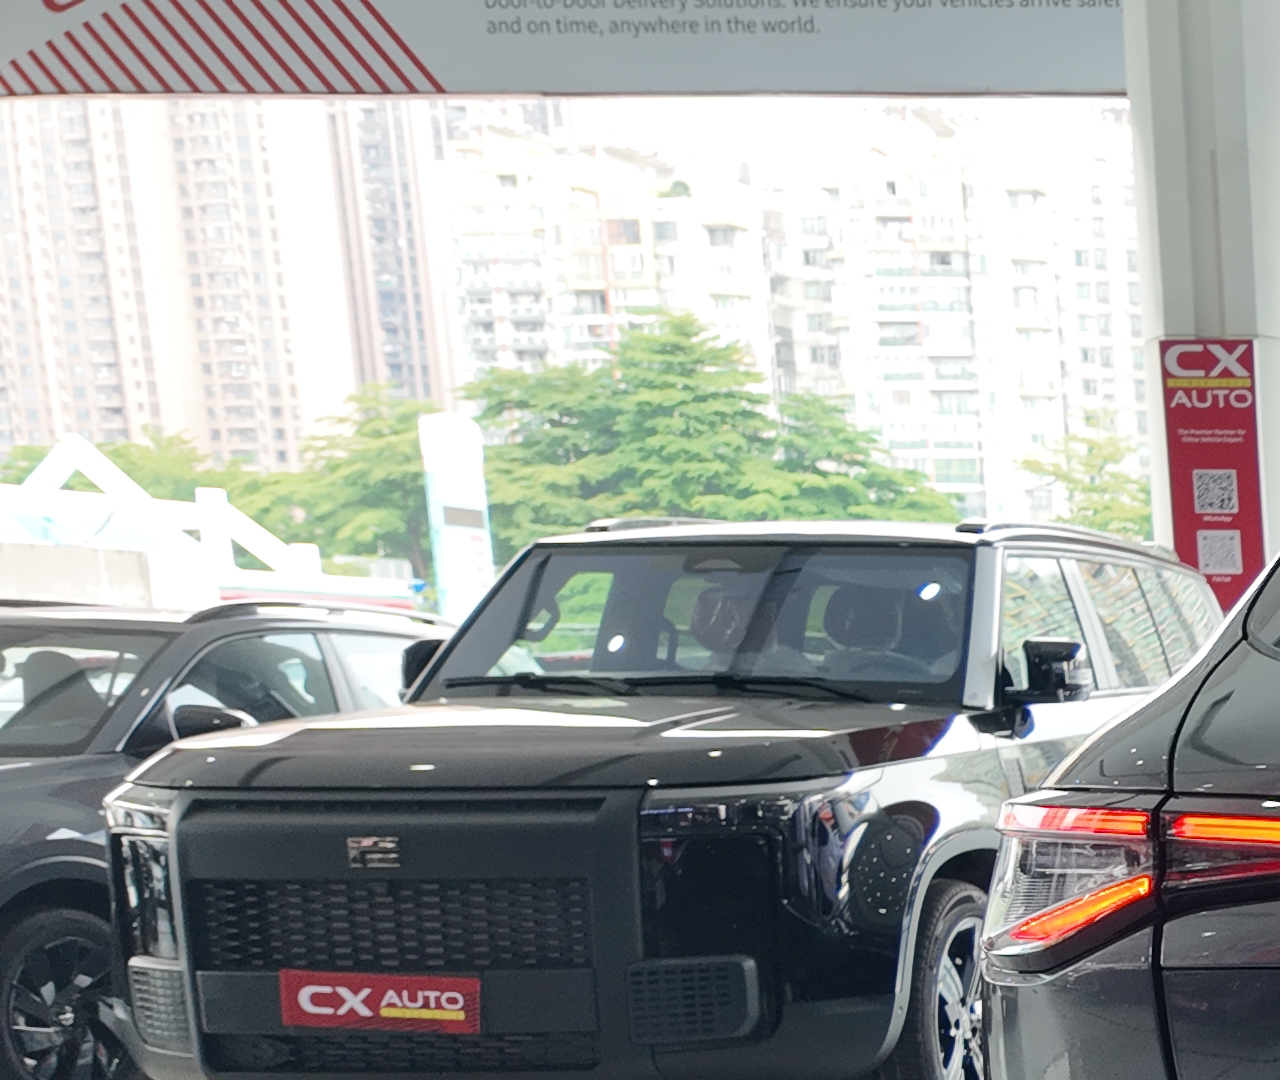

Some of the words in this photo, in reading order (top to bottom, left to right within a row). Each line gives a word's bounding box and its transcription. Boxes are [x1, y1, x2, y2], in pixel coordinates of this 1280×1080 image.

[486, 16, 522, 35] and
[526, 21, 551, 35] on
[556, 17, 604, 37] time,
[609, 16, 700, 38] anywhere
[705, 16, 722, 35] in
[726, 16, 757, 35] the
[762, 15, 820, 34] world.
[1164, 343, 1251, 377] CX
[1170, 390, 1253, 409] AUTO
[297, 984, 374, 1017] CX
[380, 989, 465, 1010] AUTO
